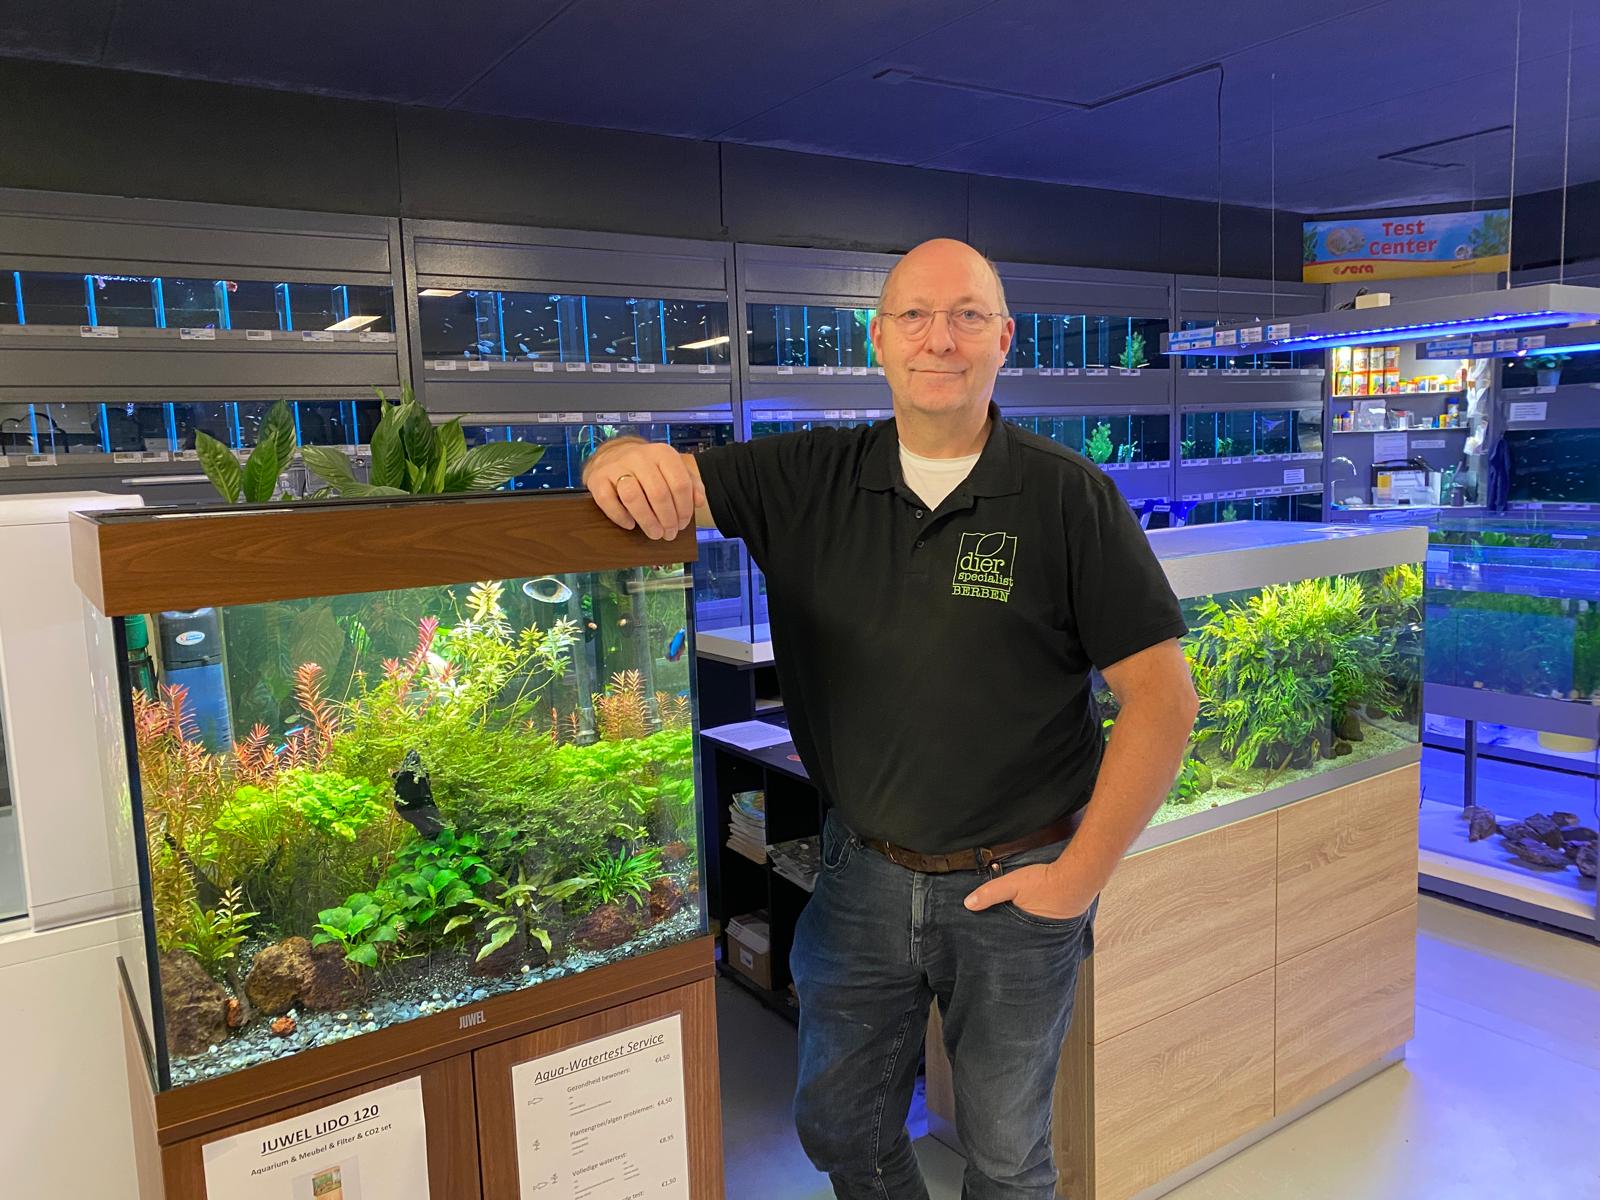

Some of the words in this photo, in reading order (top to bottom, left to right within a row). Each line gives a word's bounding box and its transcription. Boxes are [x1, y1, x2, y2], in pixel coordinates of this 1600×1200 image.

[1382, 220, 1425, 237] Test
[1369, 239, 1438, 256] Center
[1340, 264, 1374, 275] sera
[960, 552, 1005, 573] dier
[958, 571, 1014, 587] specialist
[952, 585, 1010, 602] BERBEN
[458, 1010, 487, 1030] JUWEL
[534, 1045, 624, 1084] Aqua-Watertest
[627, 1034, 664, 1053] Service
[566, 1077, 601, 1093] Gezondheid
[261, 1128, 312, 1154] JUWEL
[316, 1115, 349, 1135] LIDO
[354, 1104, 379, 1122] 120
[569, 1115, 623, 1138] Plantengroei/algen
[250, 1159, 289, 1176] Aquarium
[298, 1145, 327, 1160] Meubel
[336, 1136, 356, 1147] Filter
[364, 1127, 380, 1138] CO2
[381, 1123, 392, 1132] set
[571, 1163, 598, 1177] Volledige
